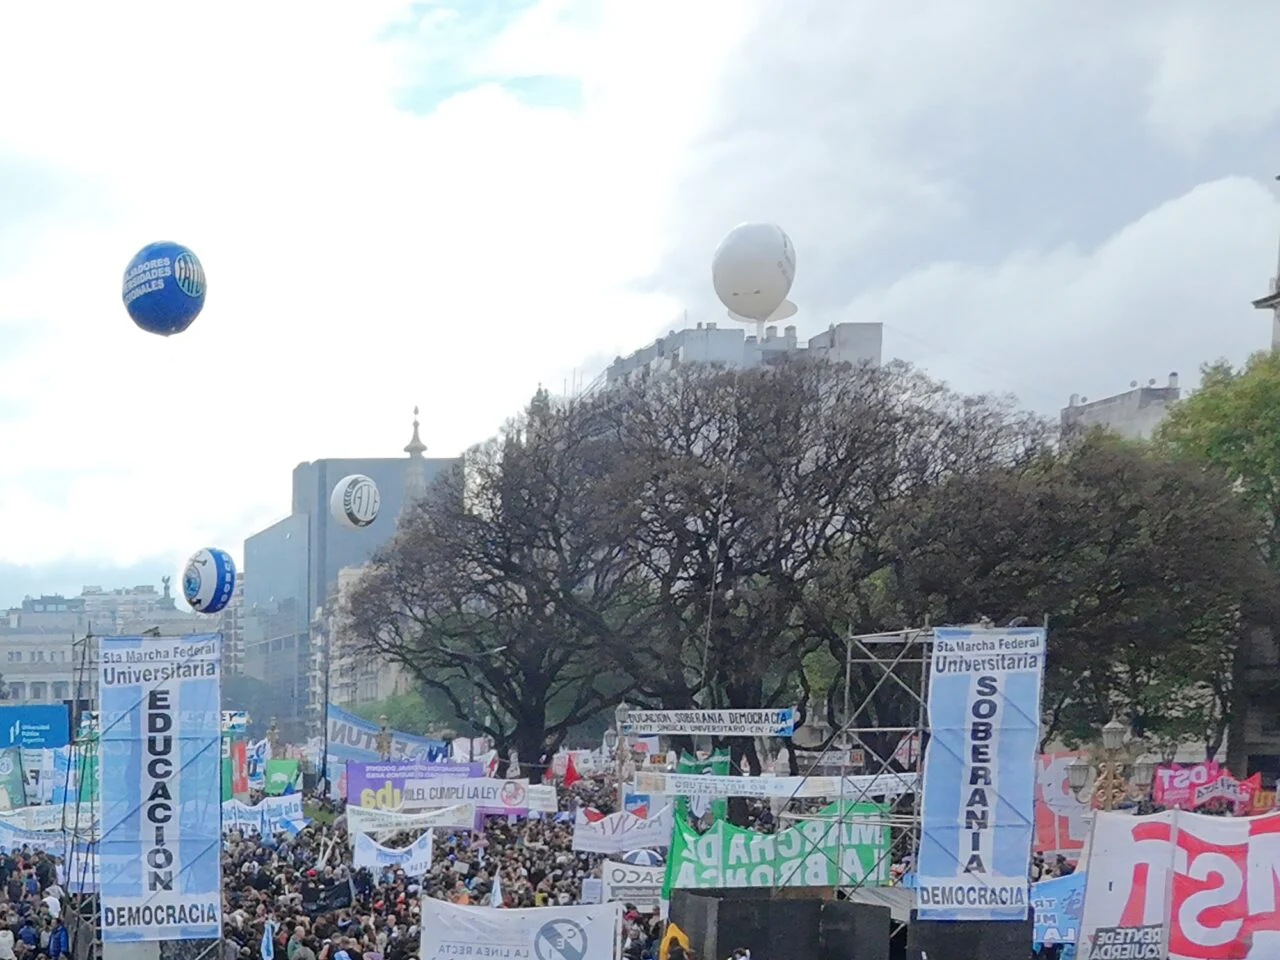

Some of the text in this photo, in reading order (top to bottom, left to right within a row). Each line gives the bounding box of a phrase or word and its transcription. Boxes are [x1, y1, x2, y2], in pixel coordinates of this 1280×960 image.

[126, 649, 169, 663] Marcha
[173, 643, 216, 658] Federal
[956, 637, 994, 652] Marcha
[998, 635, 1040, 651] Federal
[103, 659, 216, 685] Universitaria
[935, 652, 1039, 674] Universitaria
[675, 711, 724, 724] SOBERANIA
[730, 711, 788, 725] DEMOCRACIA
[962, 675, 999, 876] SOBERANIA
[467, 787, 479, 798] LA
[481, 787, 498, 799] LEY
[920, 886, 1026, 907] DEMOCRACIA
[104, 903, 218, 927] DEMOCRACIA
